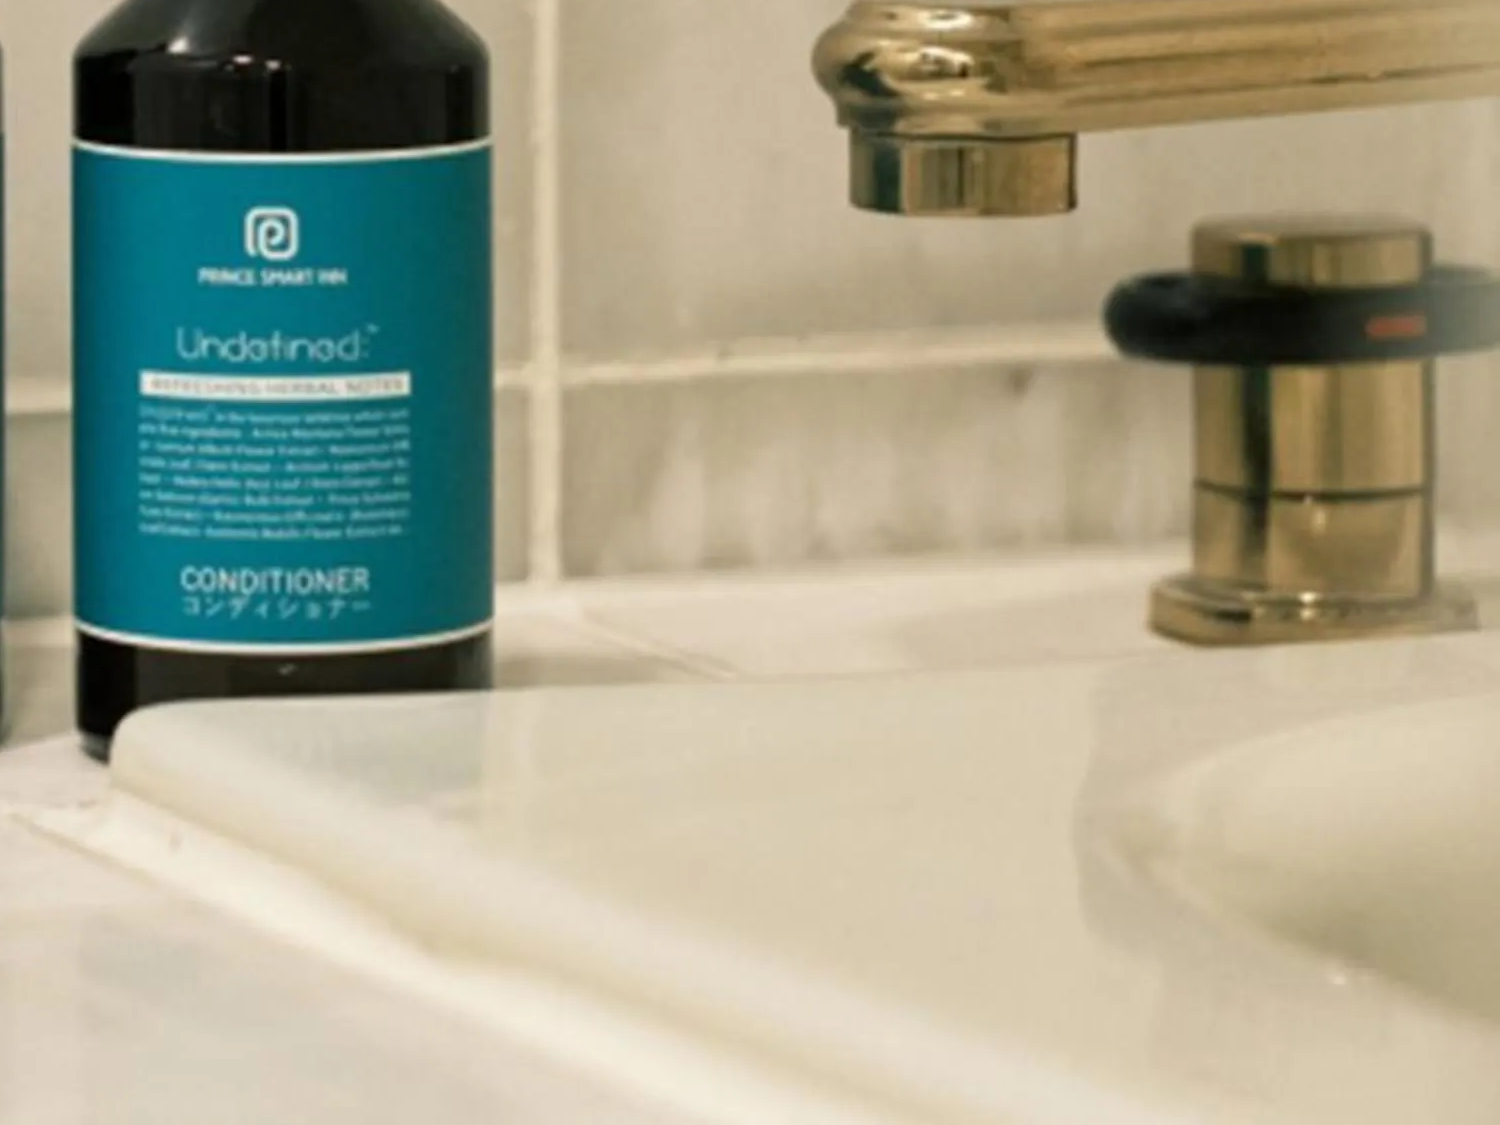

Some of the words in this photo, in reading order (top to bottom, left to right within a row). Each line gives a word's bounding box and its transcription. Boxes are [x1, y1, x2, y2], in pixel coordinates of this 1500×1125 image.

[197, 267, 256, 285] PRINCE
[261, 268, 314, 285] SMART
[318, 268, 349, 285] INN
[180, 565, 370, 595] CONDITIONER
[182, 595, 371, 620] コンディショナー
